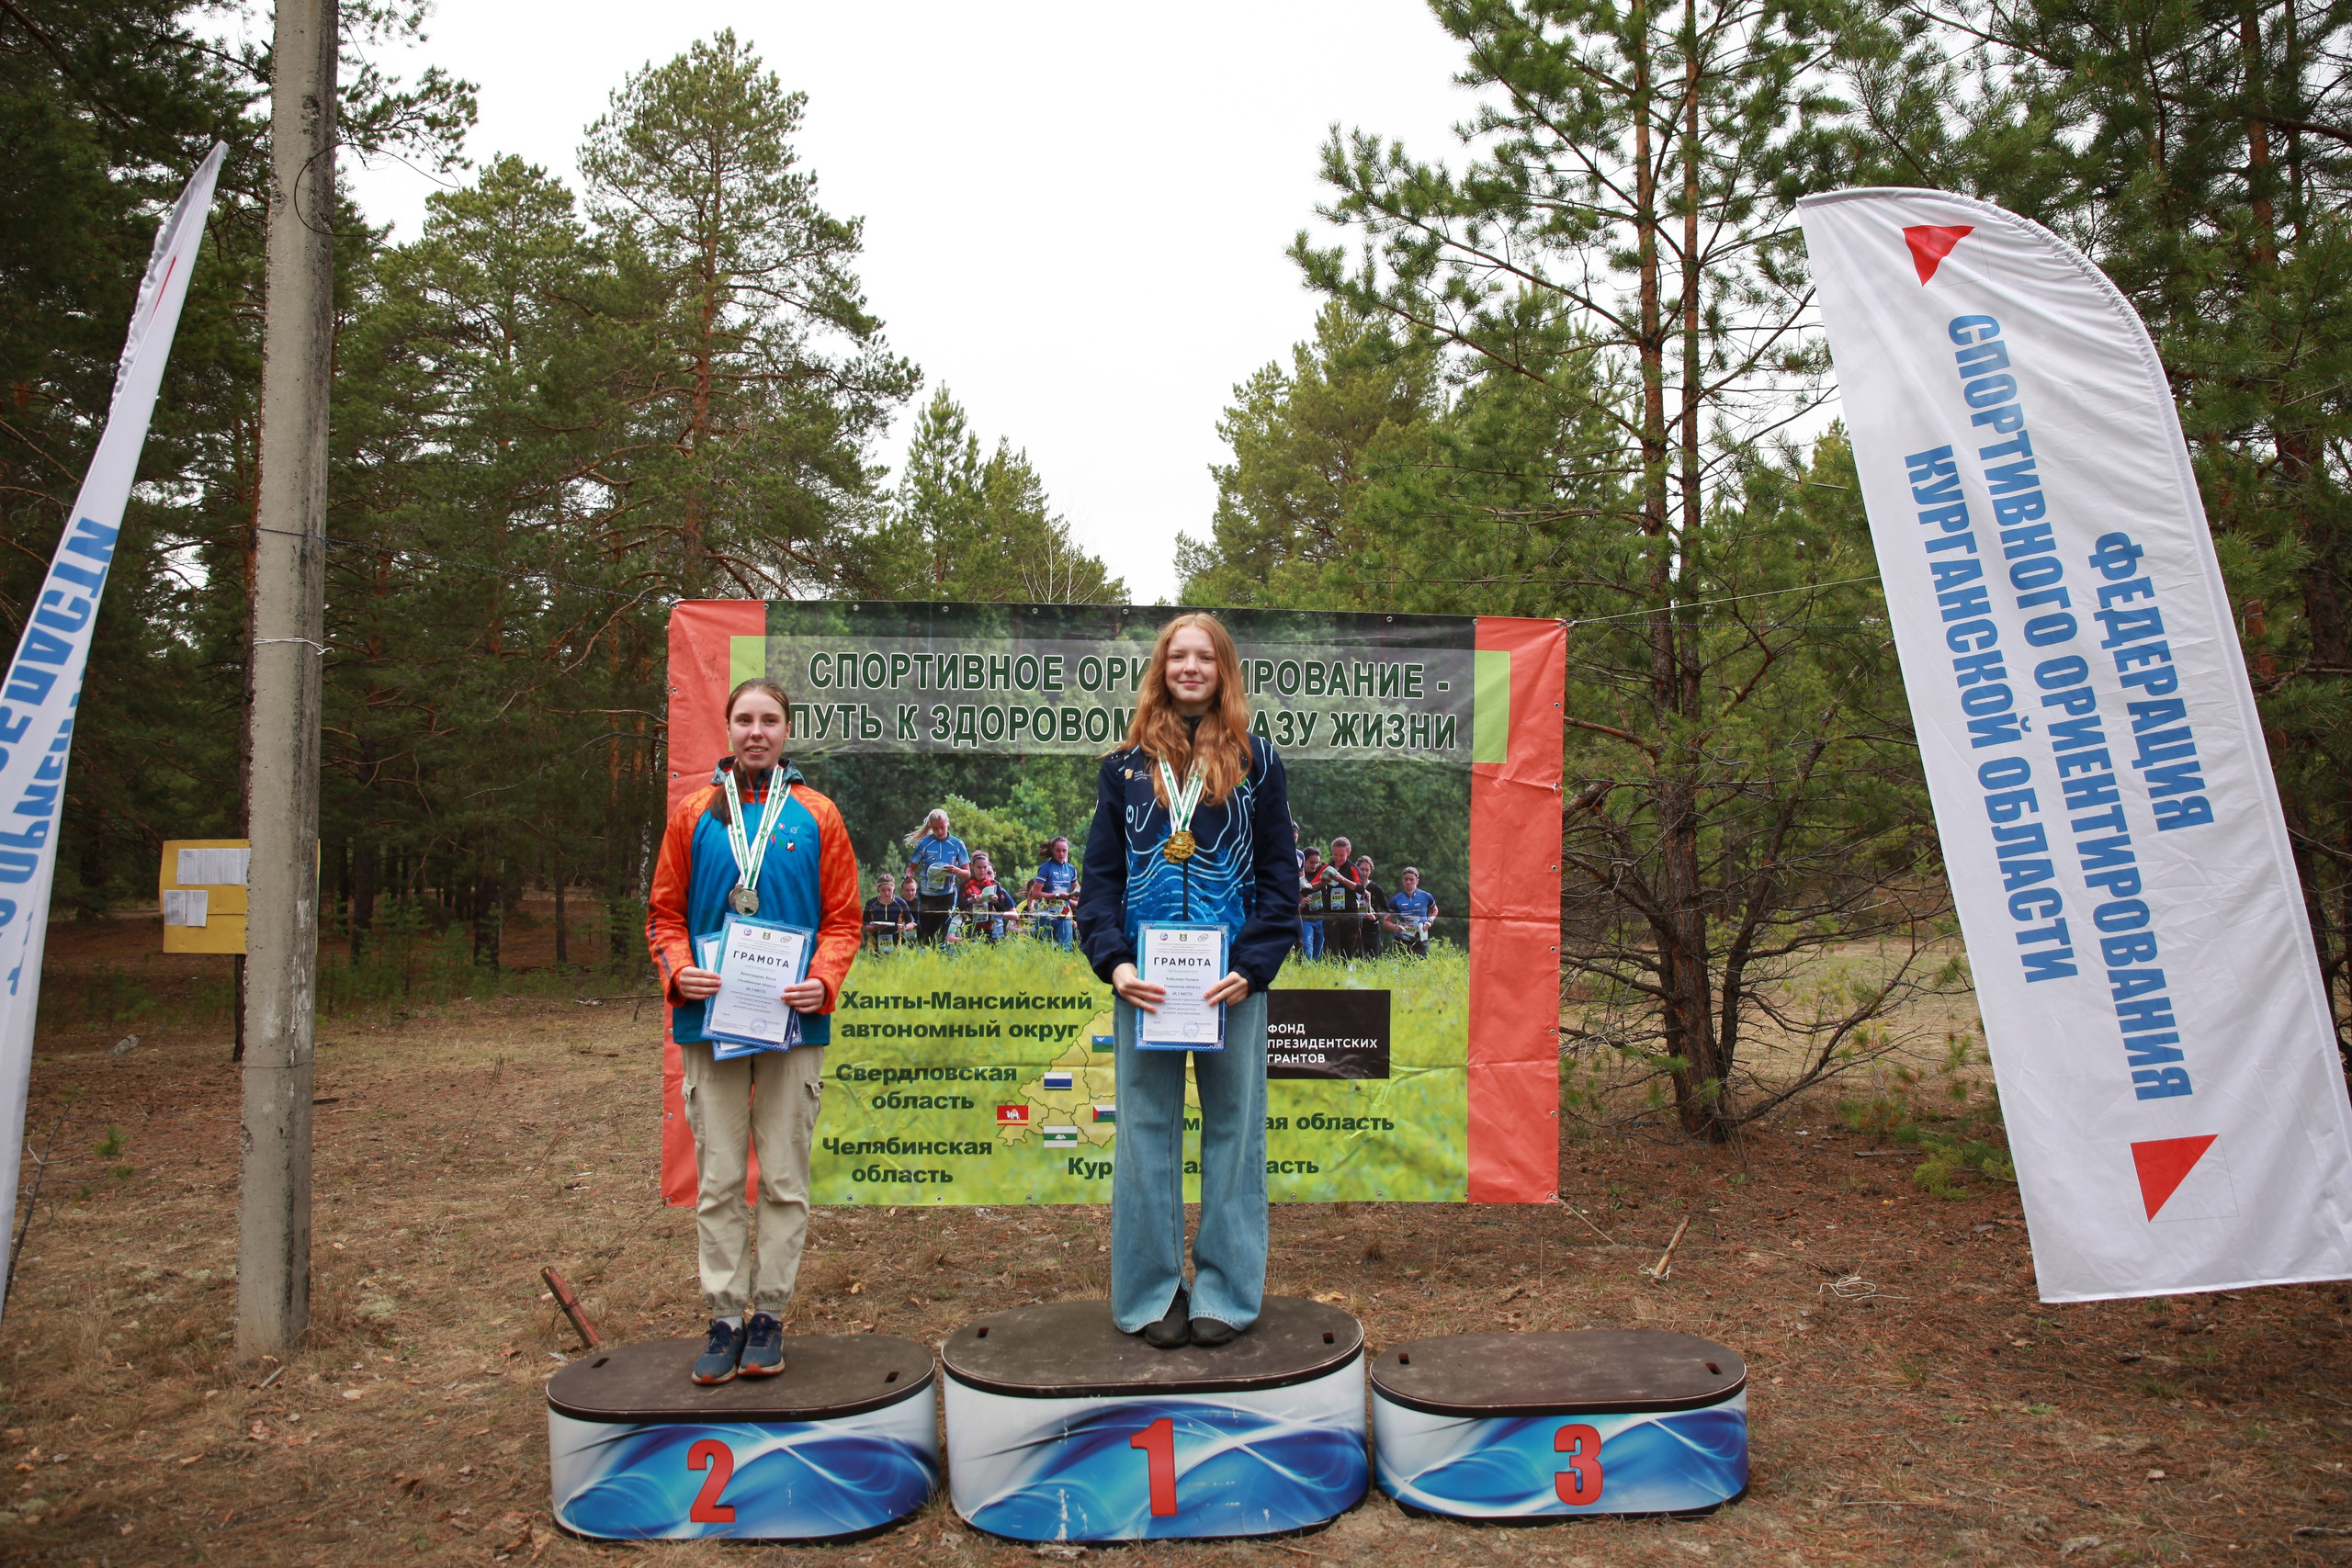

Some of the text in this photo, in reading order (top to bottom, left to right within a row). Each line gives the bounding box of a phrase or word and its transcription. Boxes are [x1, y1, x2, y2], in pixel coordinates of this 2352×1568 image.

[808, 651, 1065, 693] СПОРТИВНОЕ
[2087, 531, 2214, 831] ФЕДЕРАЦИЯ
[1905, 445, 2078, 983] КУРГАНСКОЙ ОБЛАСТИ
[1948, 314, 2193, 1100] СПОРТИВНОГО ОРИЕНТИРОВАНИЯ
[787, 703, 1457, 750] ПУТЬ К ЗДОРОВОМ АЗУ ЖИЗНИ
[733, 950, 790, 968] ГРАМОТА
[1153, 956, 1212, 966] ГРАМОТА
[841, 991, 1092, 1010] Ханты-Мансийский
[841, 1020, 1079, 1042] автономный округ
[1268, 1023, 1306, 1034] ФОНД
[1267, 1038, 1378, 1049] ПРЕЗИДЕНТСКИХ
[1267, 1054, 1326, 1064] ГРАНТОВ
[836, 1064, 1017, 1085] Свердловская
[872, 1091, 975, 1110] область
[1296, 1112, 1395, 1131] область
[822, 1136, 992, 1156] Челябинская
[852, 1164, 954, 1183] область
[1266, 1158, 1319, 1174] асть
[1129, 1417, 1178, 1516] 1
[1554, 1424, 1603, 1506] 3
[687, 1438, 736, 1523] 2
